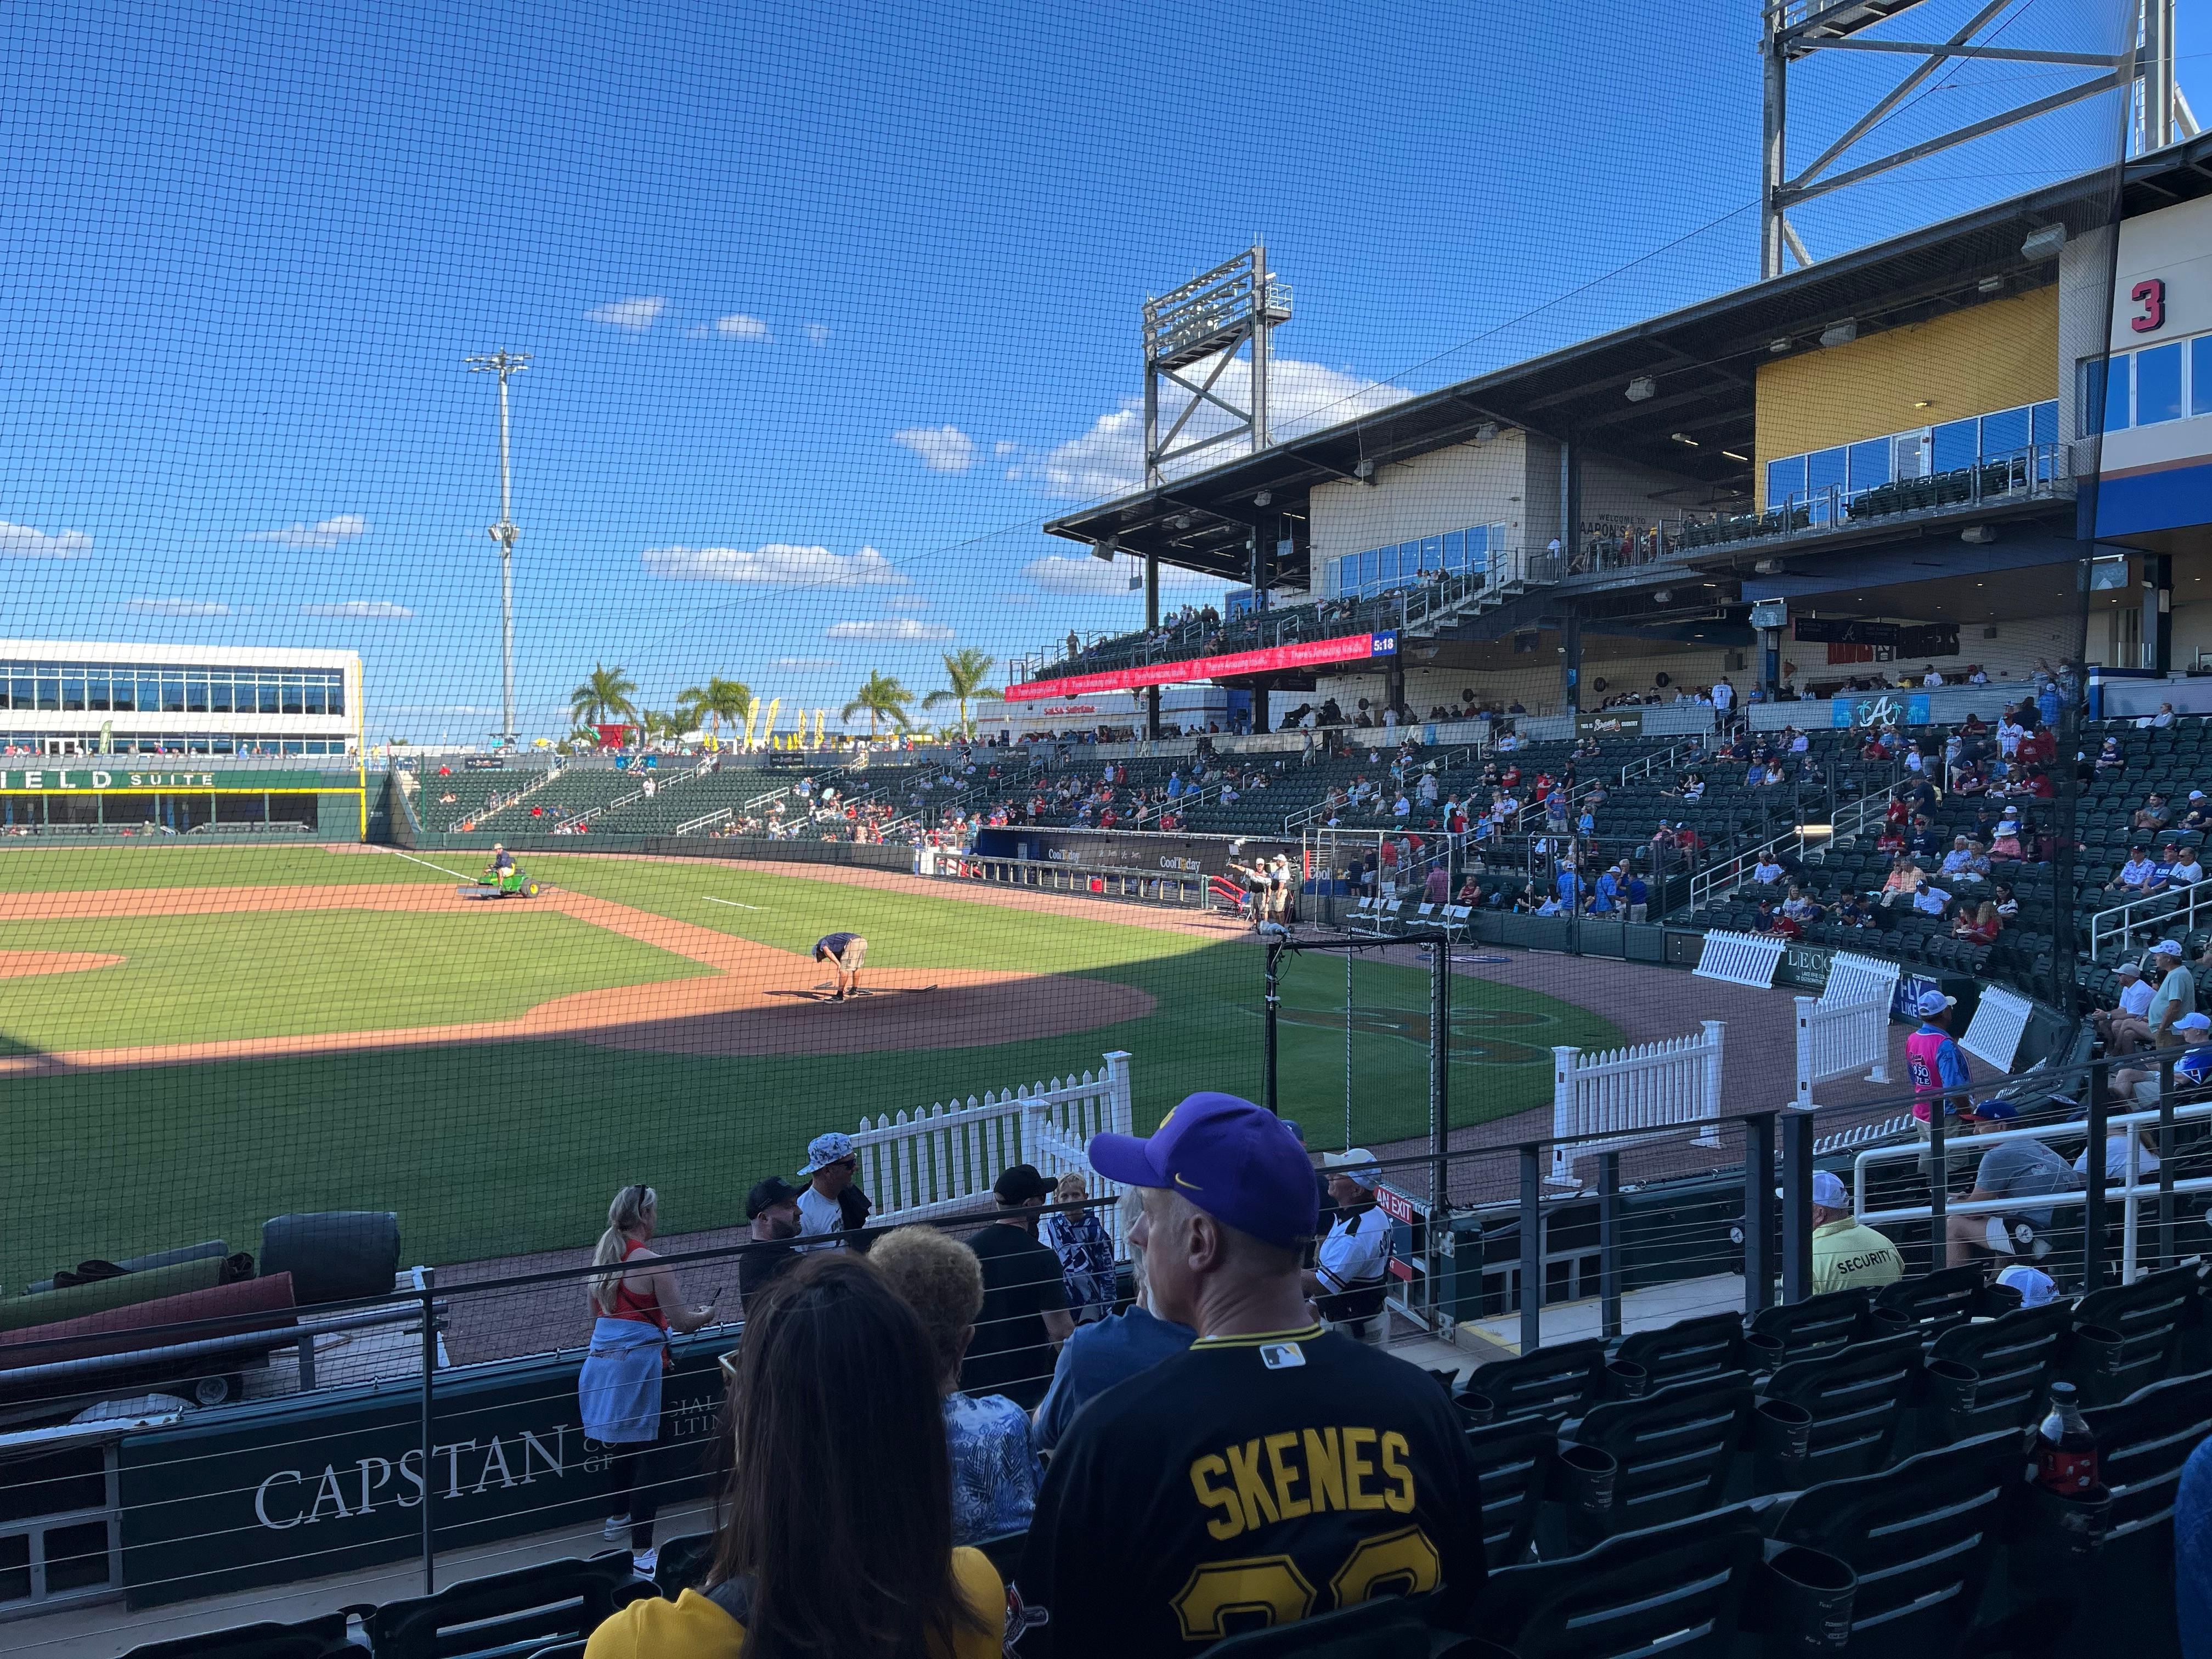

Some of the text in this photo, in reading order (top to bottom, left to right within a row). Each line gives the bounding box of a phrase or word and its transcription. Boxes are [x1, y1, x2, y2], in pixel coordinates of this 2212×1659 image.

[2131, 278, 2166, 333] 3
[1374, 637, 1394, 652] 5:18
[131, 774, 215, 786] SUITE
[1901, 1000, 1917, 1018] LIKE
[1377, 1189, 1412, 1221] AN EXIT
[1837, 1248, 1892, 1274] SECURITY
[254, 1424, 571, 1530] CAPSTAN
[1189, 1426, 1417, 1541] SKENES
